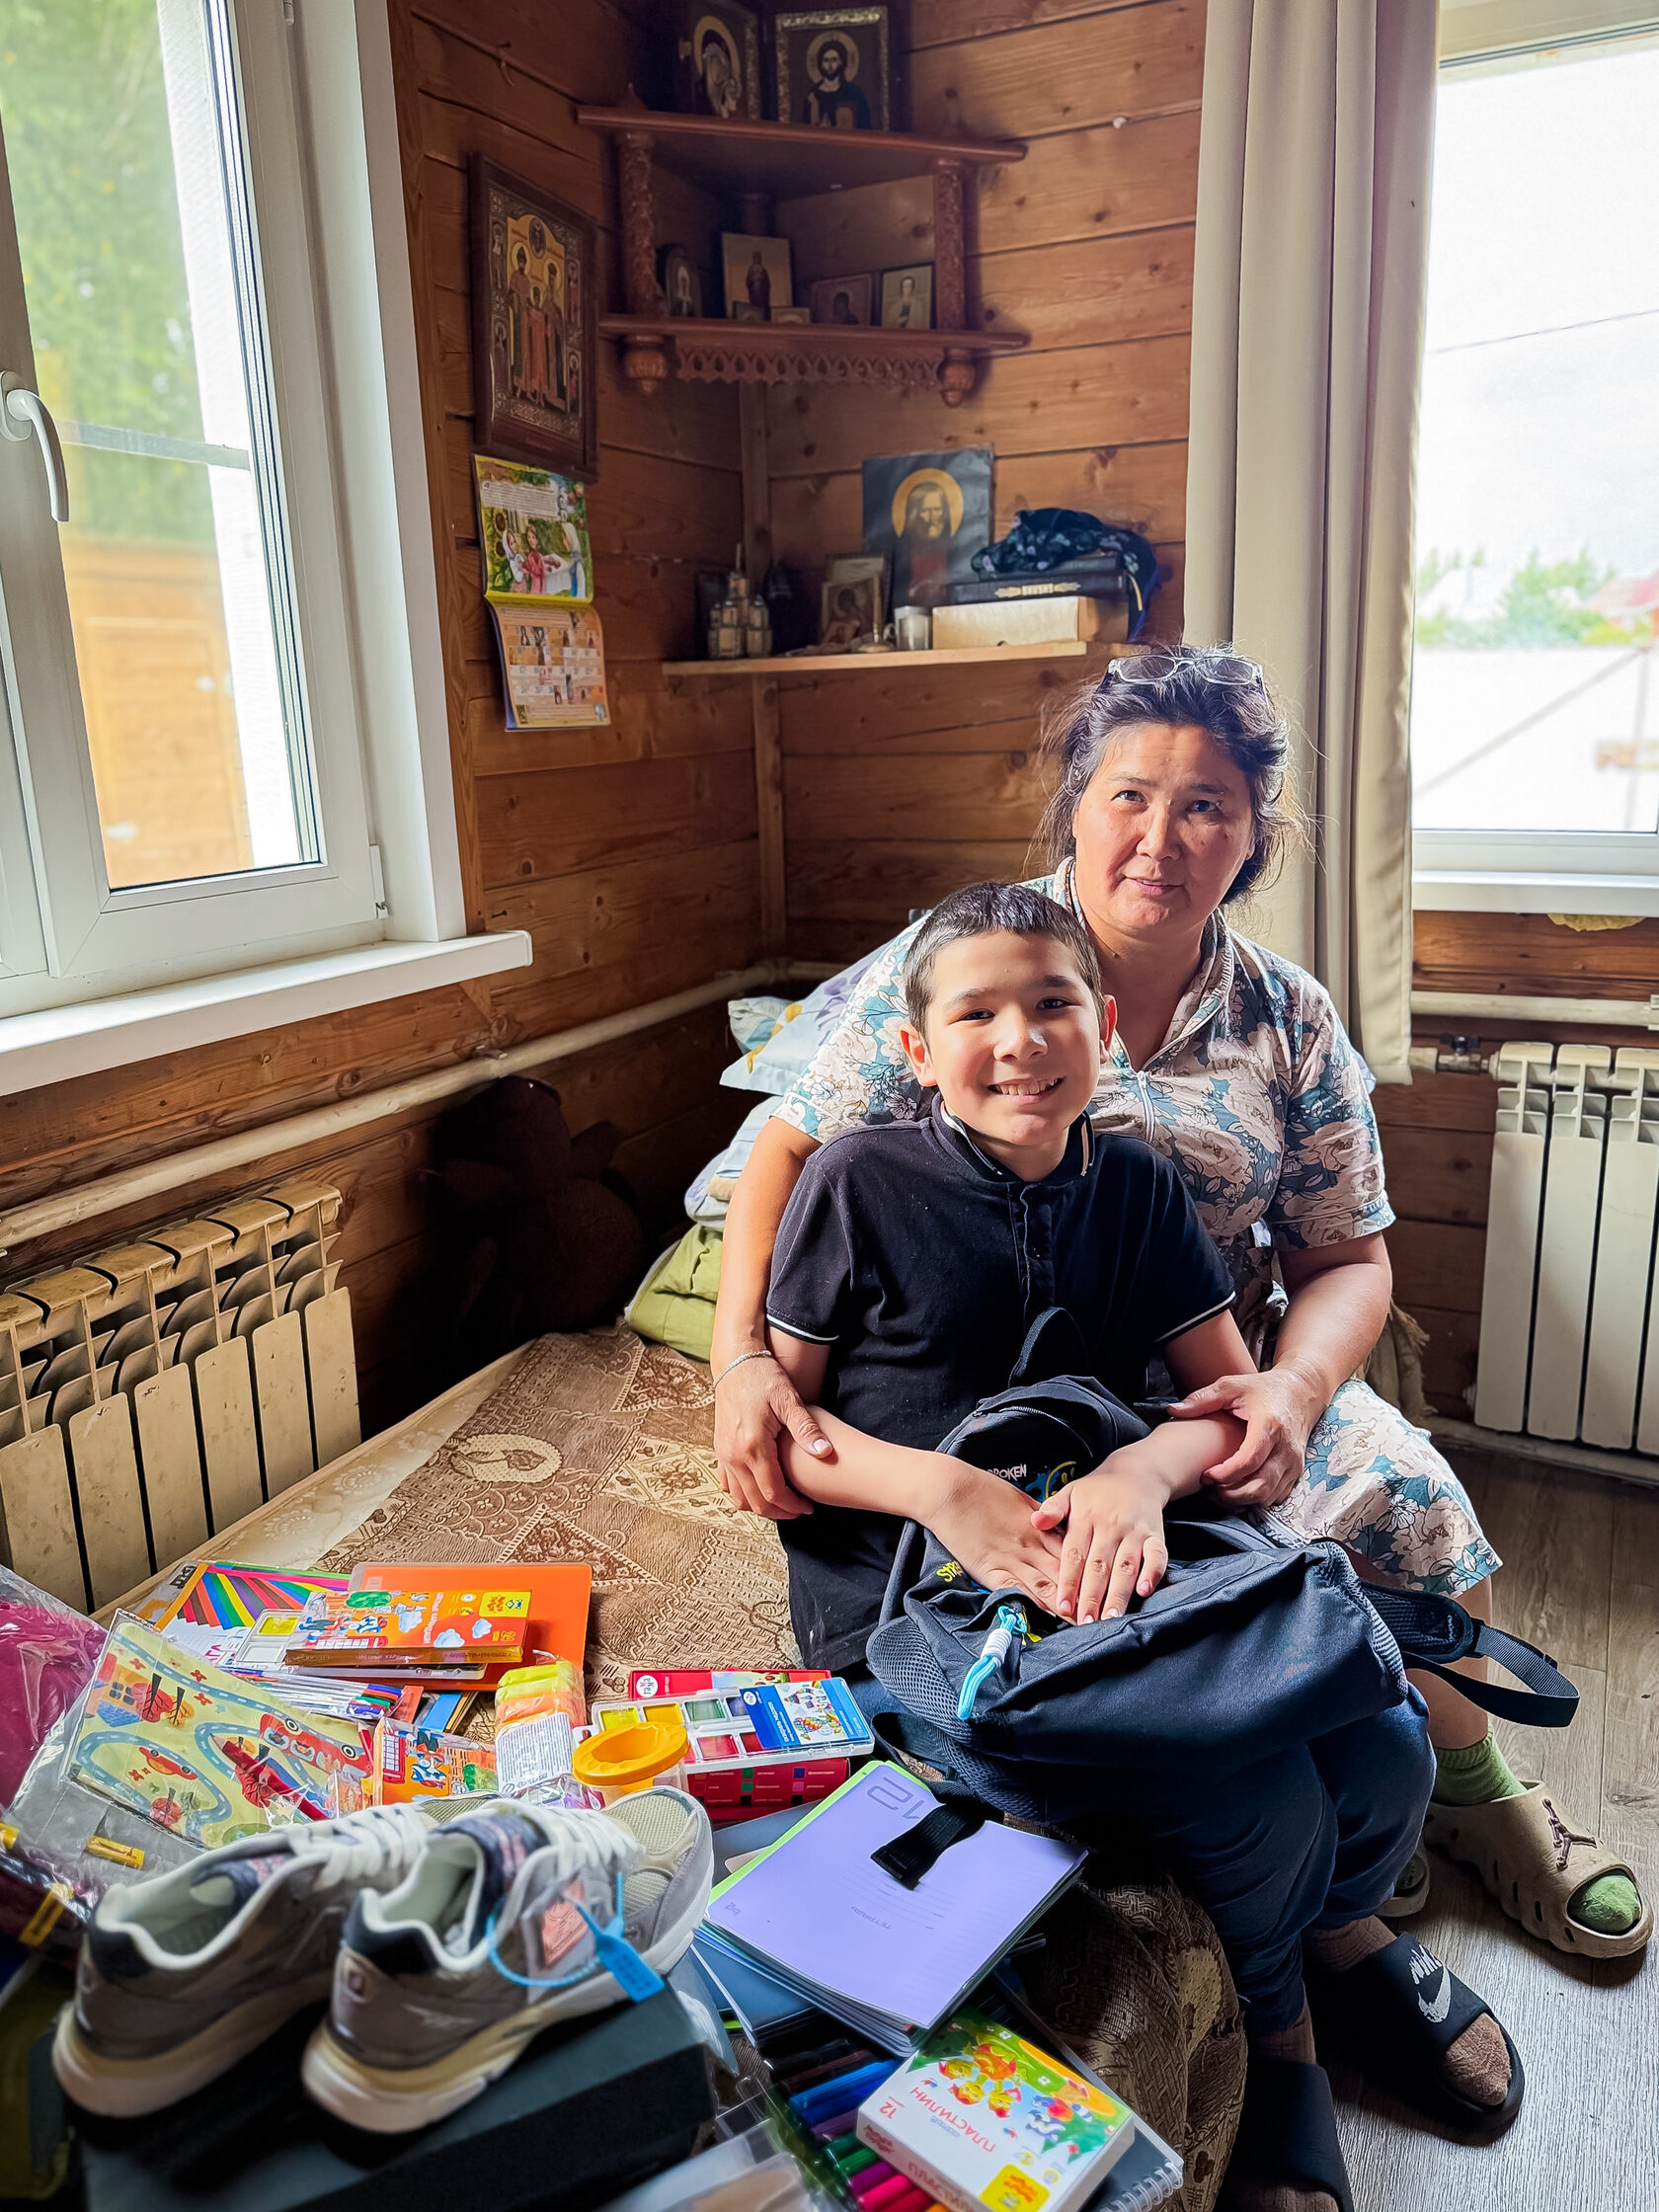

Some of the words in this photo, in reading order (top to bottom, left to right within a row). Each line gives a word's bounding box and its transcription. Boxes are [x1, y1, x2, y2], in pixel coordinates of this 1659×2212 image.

[988, 1463, 1027, 1481] ROKEN
[868, 1777, 925, 1819] 12
[879, 2101, 898, 2119] 12
[910, 2087, 996, 2153] ПЛАСТИЛИН
